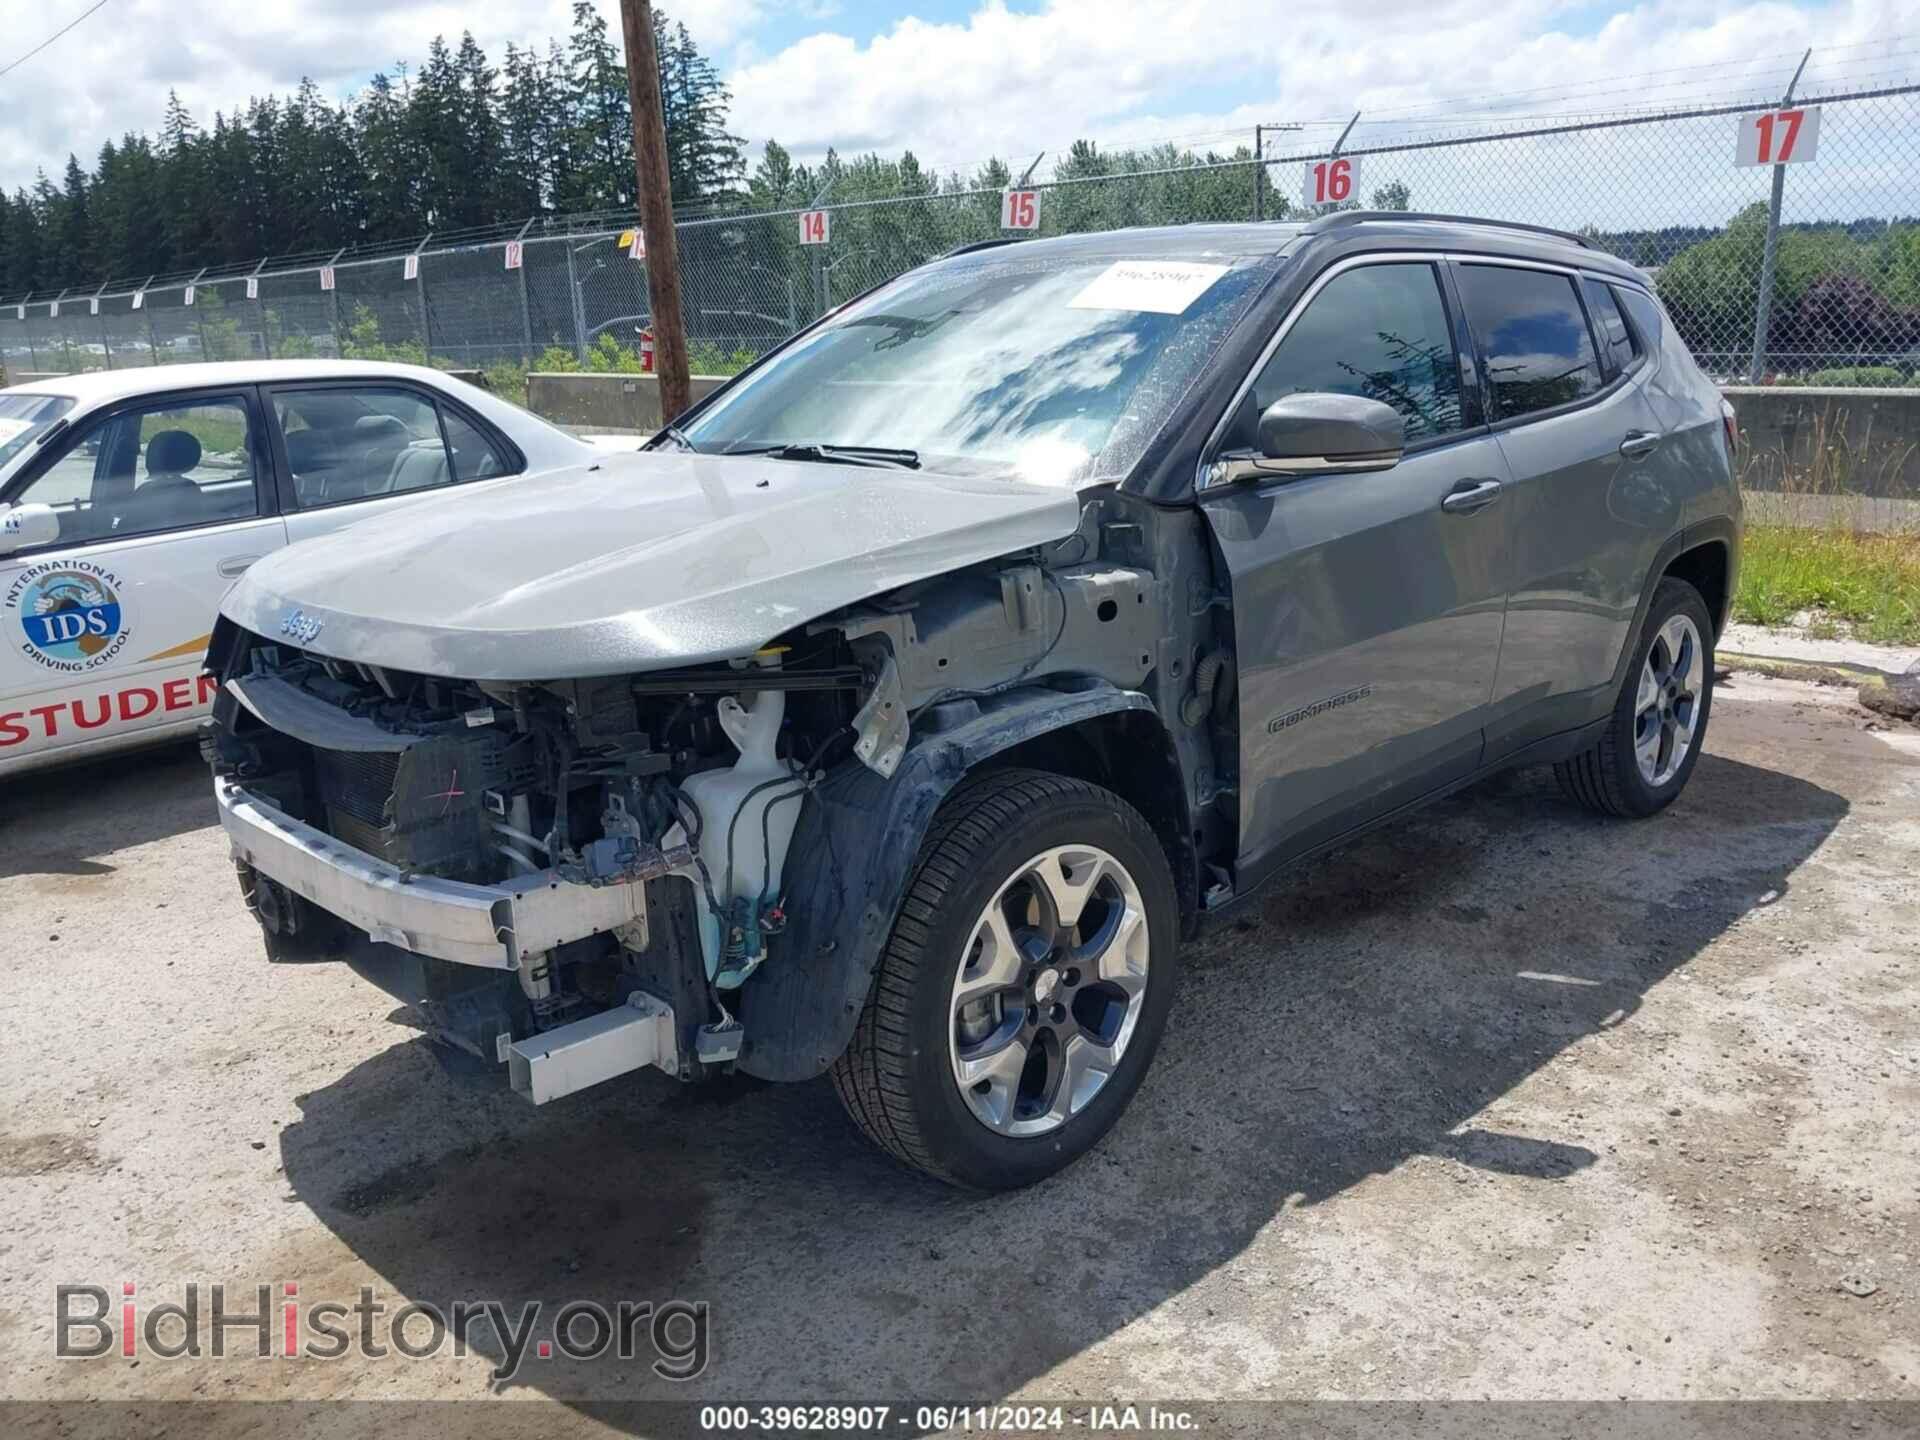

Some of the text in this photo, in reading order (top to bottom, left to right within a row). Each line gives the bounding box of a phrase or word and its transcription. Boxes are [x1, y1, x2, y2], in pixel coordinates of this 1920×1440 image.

[1756, 111, 1804, 163] 17
[1313, 160, 1351, 202] 16
[803, 212, 825, 241] 14
[1009, 193, 1034, 226] 15
[507, 242, 520, 266] 12
[6, 561, 122, 608] INTERNATIONAL
[41, 608, 108, 643] IDS
[22, 628, 130, 671] DRIVING SCHOOL
[1270, 685, 1372, 733] COMPASS
